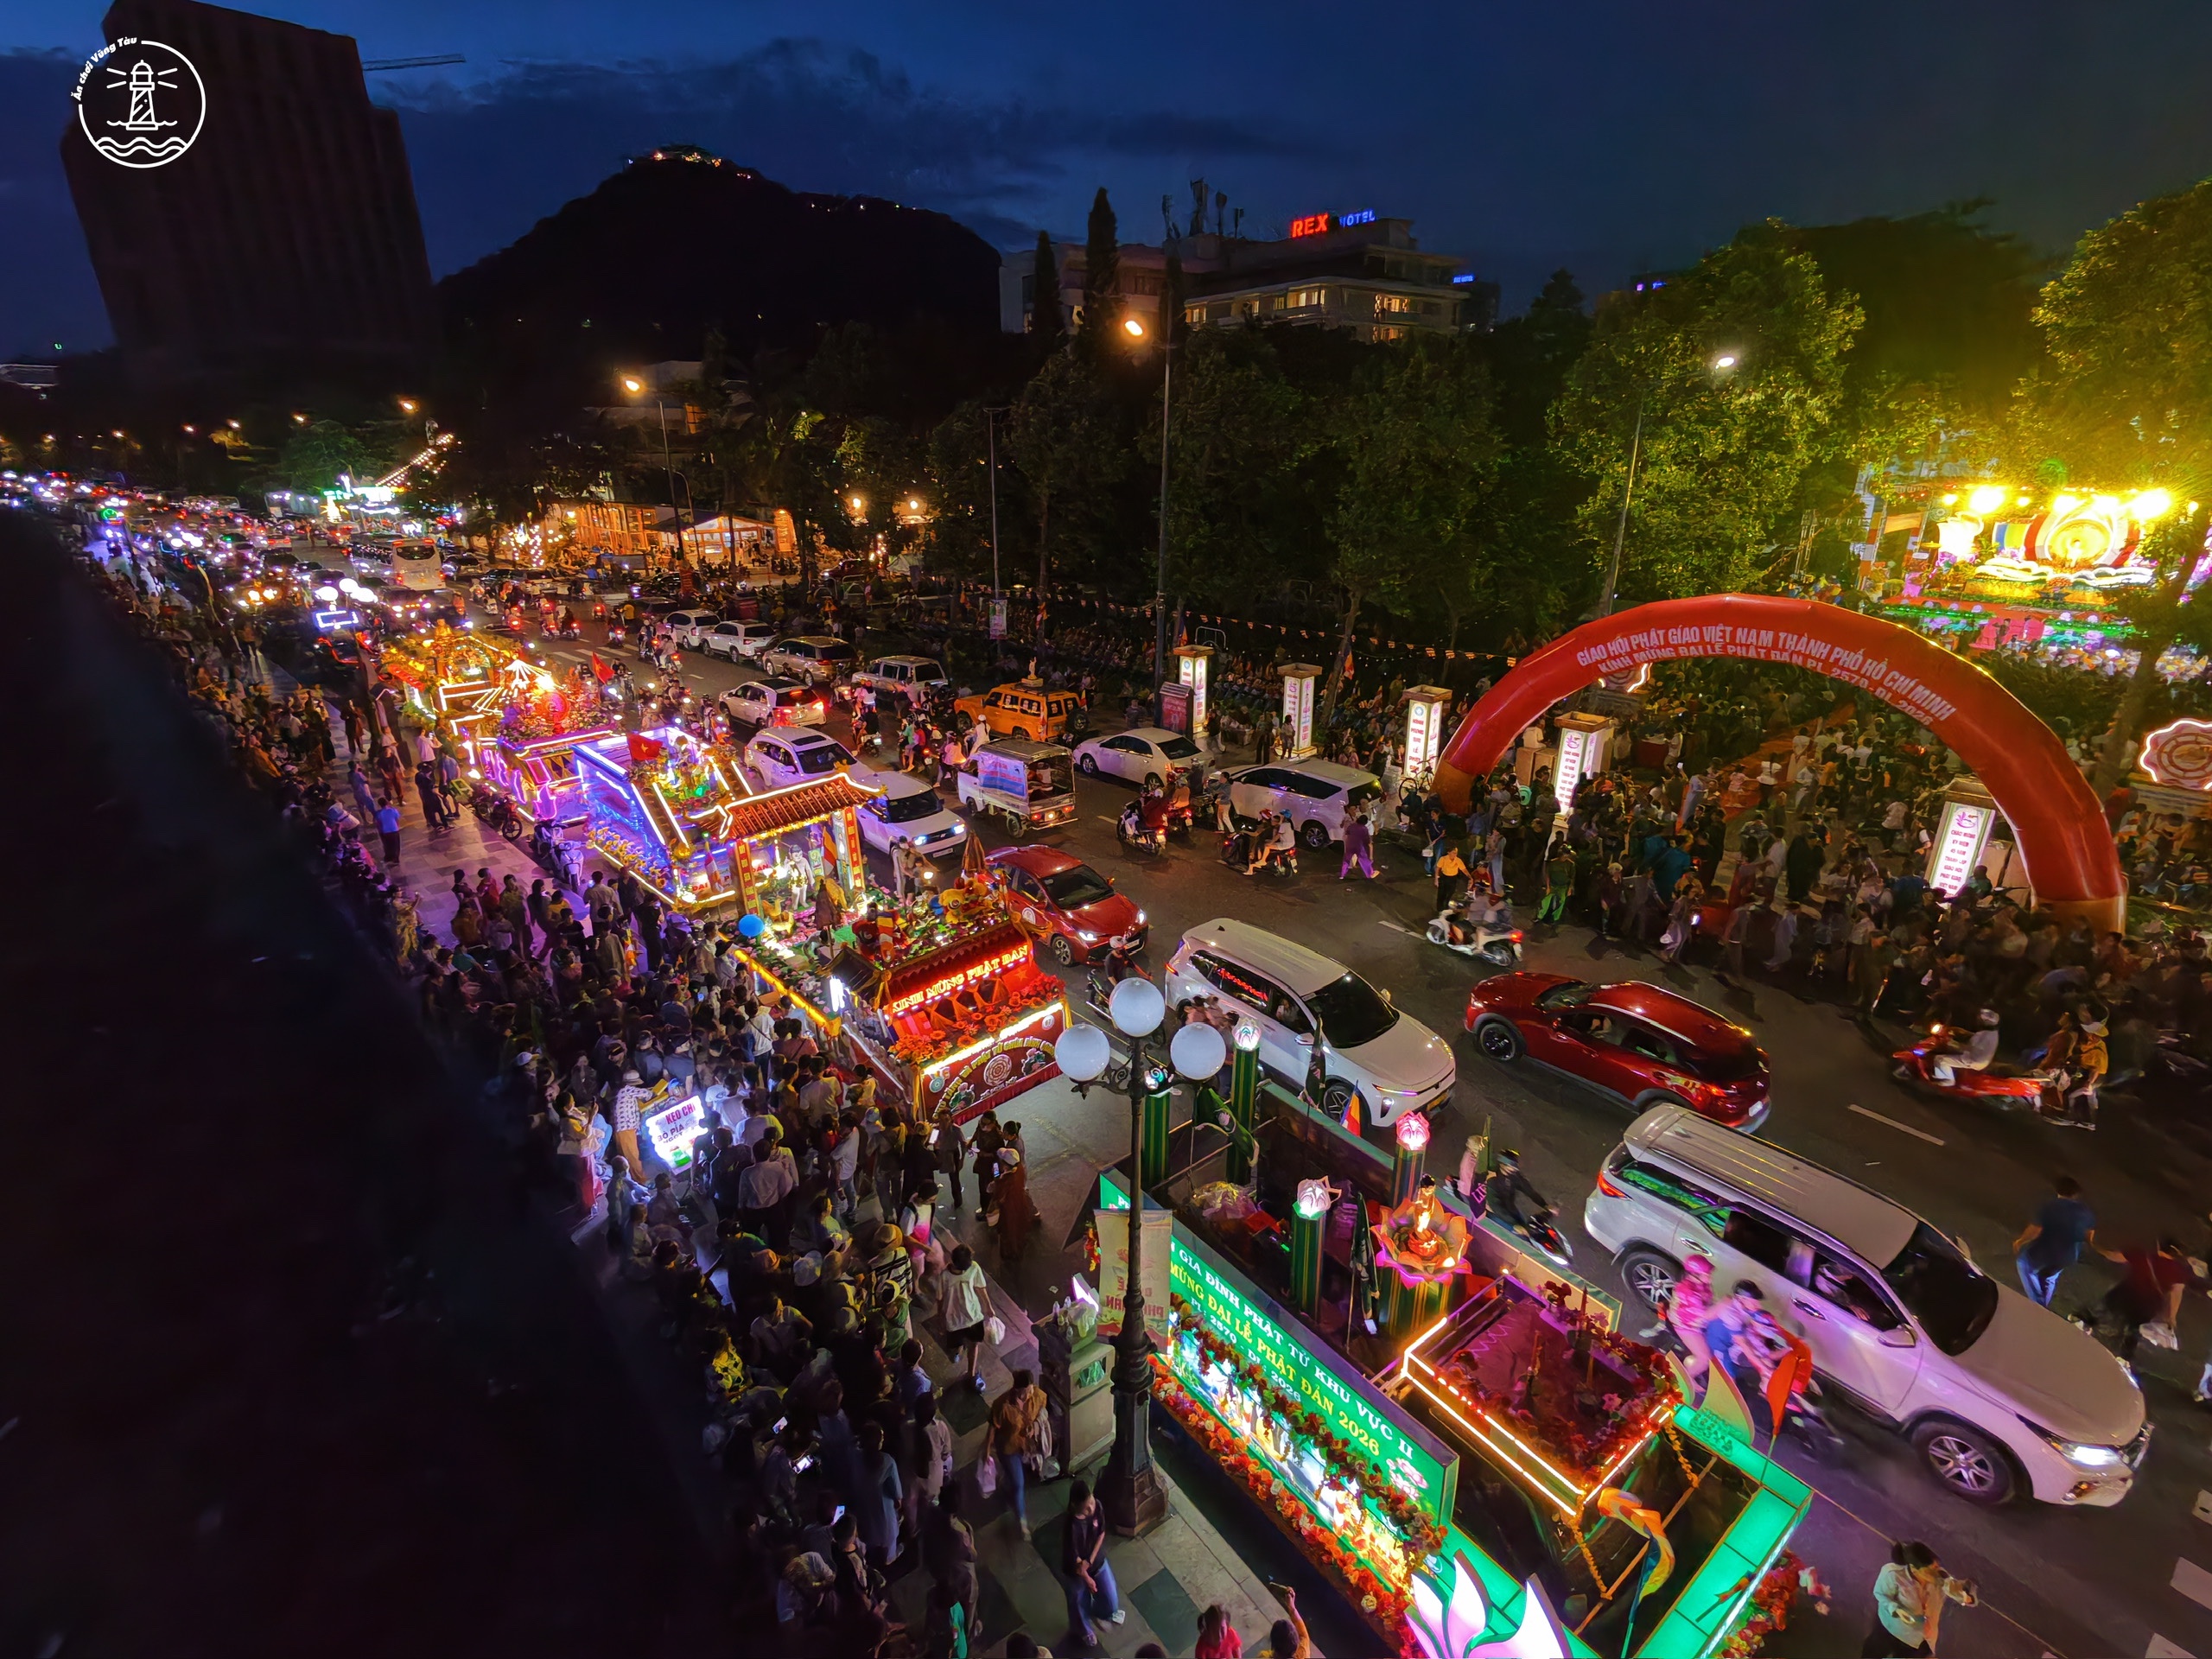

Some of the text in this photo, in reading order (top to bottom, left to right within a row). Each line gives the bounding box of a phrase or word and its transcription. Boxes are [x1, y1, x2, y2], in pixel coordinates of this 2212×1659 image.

[1292, 209, 1376, 238] REX HOTEL
[1607, 635, 1630, 657] HỘI
[1630, 627, 1666, 650] PHẬT
[1702, 623, 1732, 644] VIỆT
[1736, 627, 1774, 647] NAM
[1778, 632, 1831, 660] THÀNH
[1829, 647, 1866, 671] PHỐ
[1860, 658, 1889, 681] HỒ
[1884, 671, 1920, 696] CHÍ
[1908, 684, 1957, 721] MINH
[1170, 1261, 1205, 1300] MỪNG
[1208, 1294, 1232, 1325] ĐẠI
[1257, 1337, 1297, 1382] PHẬT
[1300, 1376, 1334, 1415] ĐẢN
[1338, 1410, 1380, 1456] 2026
[1179, 1249, 1202, 1276] GIA
[1205, 1270, 1240, 1309] ĐÌNH
[1243, 1304, 1284, 1345] PHẬT
[1288, 1344, 1310, 1367] TỬ
[1314, 1365, 1351, 1403] KHU
[1355, 1399, 1393, 1440] VỰC
[1398, 1437, 1414, 1460] II
[1210, 1314, 1237, 1344] 2570
[1271, 1370, 1301, 1402] 2026
